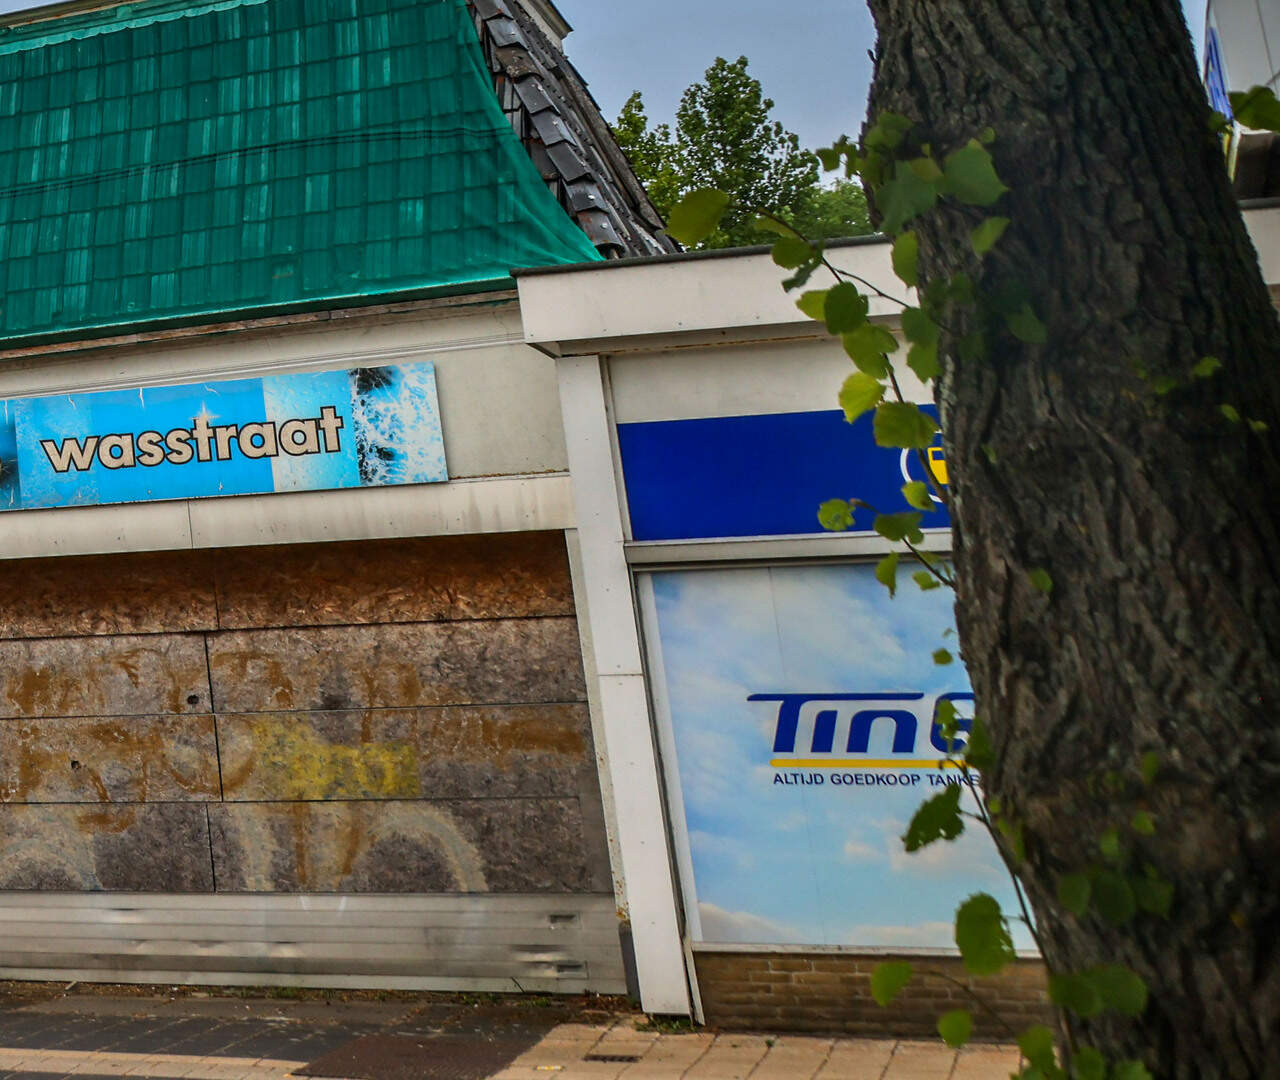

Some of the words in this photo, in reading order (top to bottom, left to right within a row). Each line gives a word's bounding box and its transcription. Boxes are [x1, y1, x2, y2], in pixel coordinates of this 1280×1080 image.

[40, 405, 345, 473] wasstraat
[773, 772, 824, 786] ALTIJD
[830, 773, 921, 786] GOEDKOOP
[926, 773, 981, 786] TANKE
